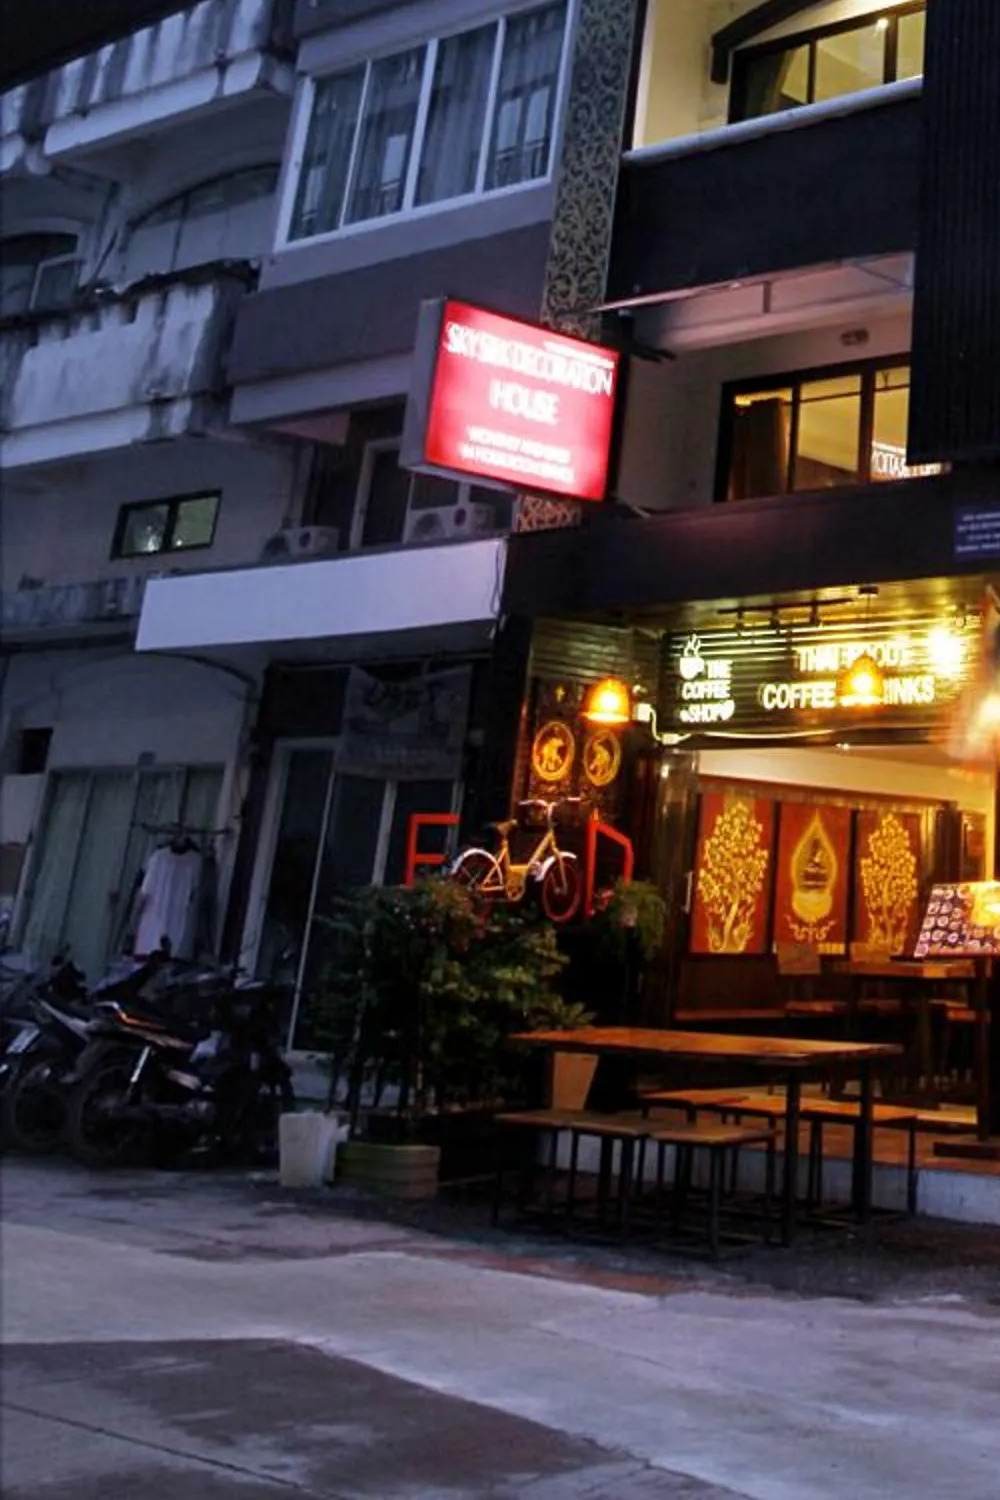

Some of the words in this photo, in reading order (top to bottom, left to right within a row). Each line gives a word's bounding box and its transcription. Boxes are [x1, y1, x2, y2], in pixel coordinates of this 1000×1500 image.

[681, 679, 732, 700] COFFEE
[761, 680, 836, 710] COFFEE
[688, 702, 722, 723] SHOP
